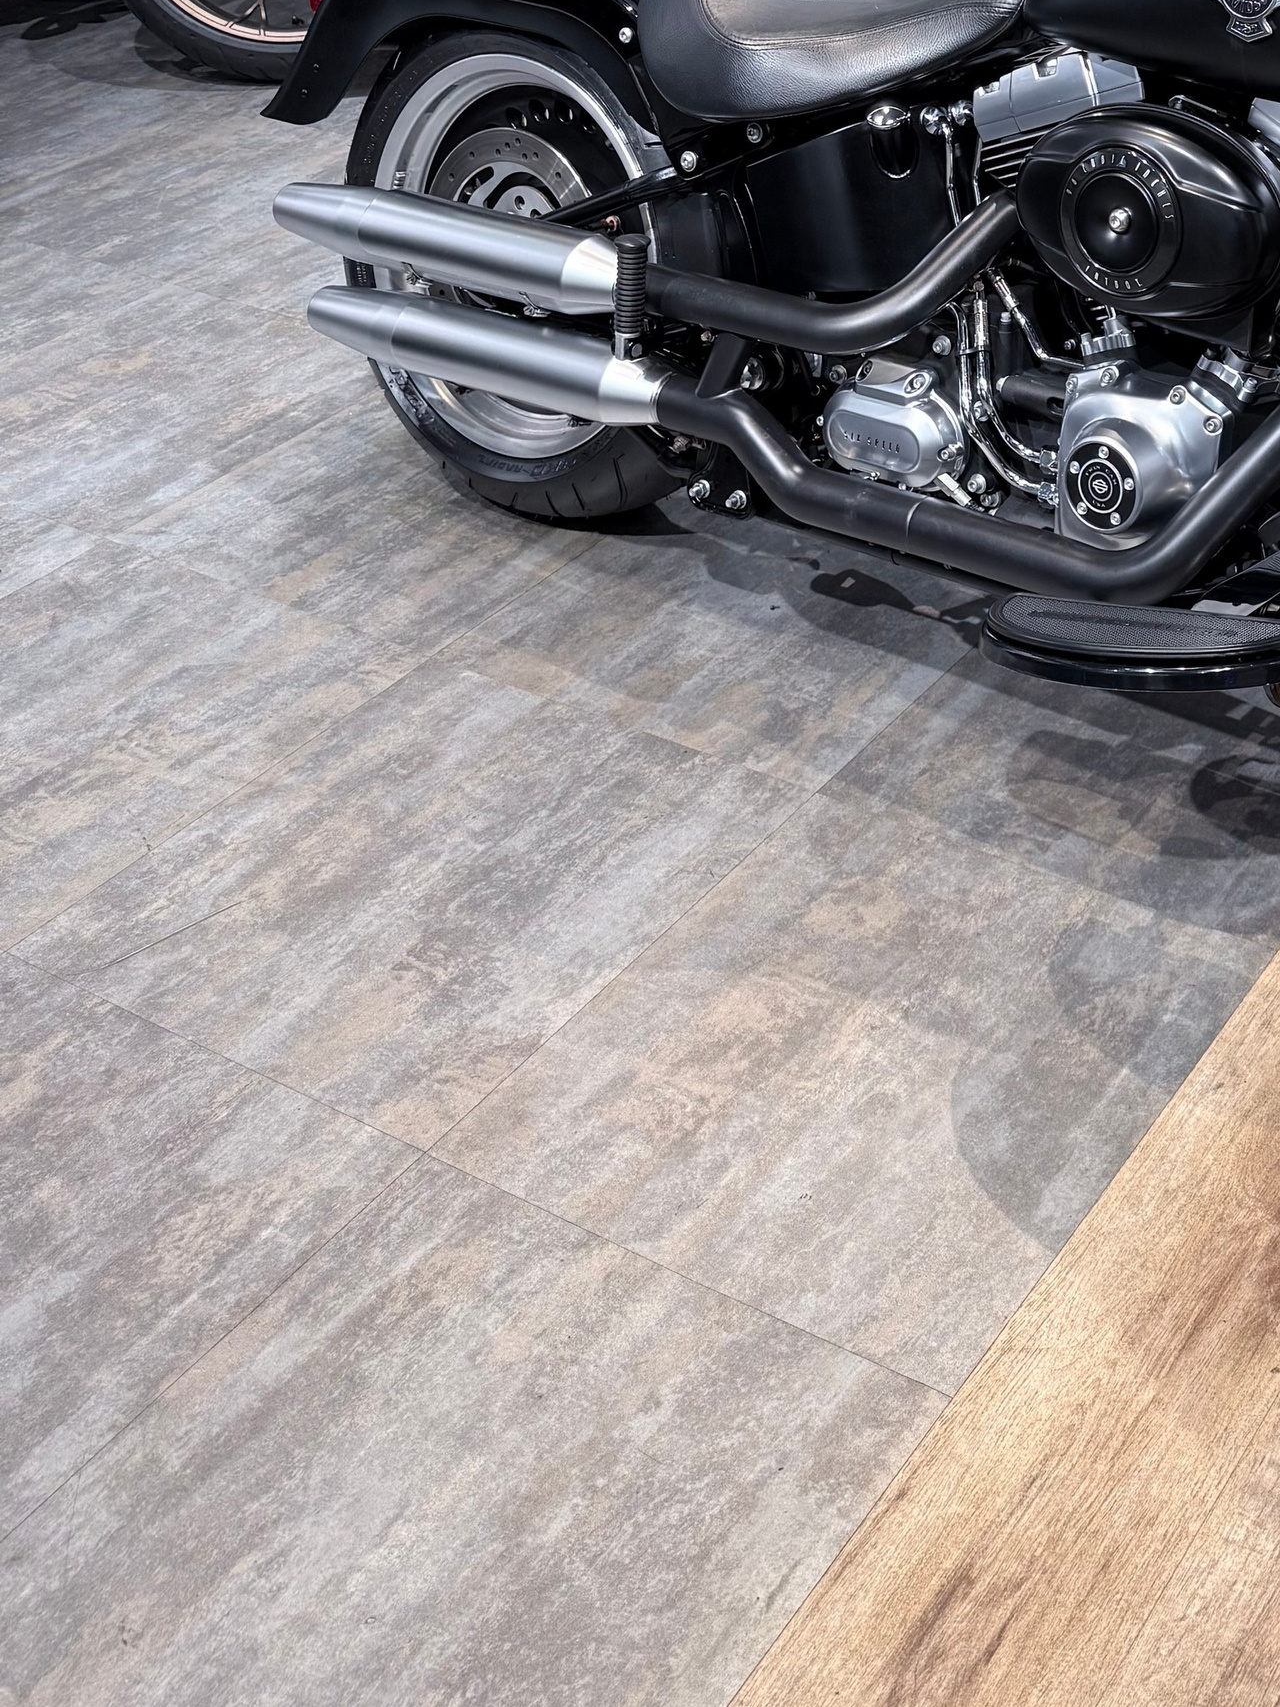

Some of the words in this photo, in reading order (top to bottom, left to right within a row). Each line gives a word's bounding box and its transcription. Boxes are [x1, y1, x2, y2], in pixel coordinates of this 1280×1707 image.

[1134, 162, 1175, 220] INCHES
[1085, 465, 1101, 476] TWIN
[1105, 468, 1118, 486] CAM
